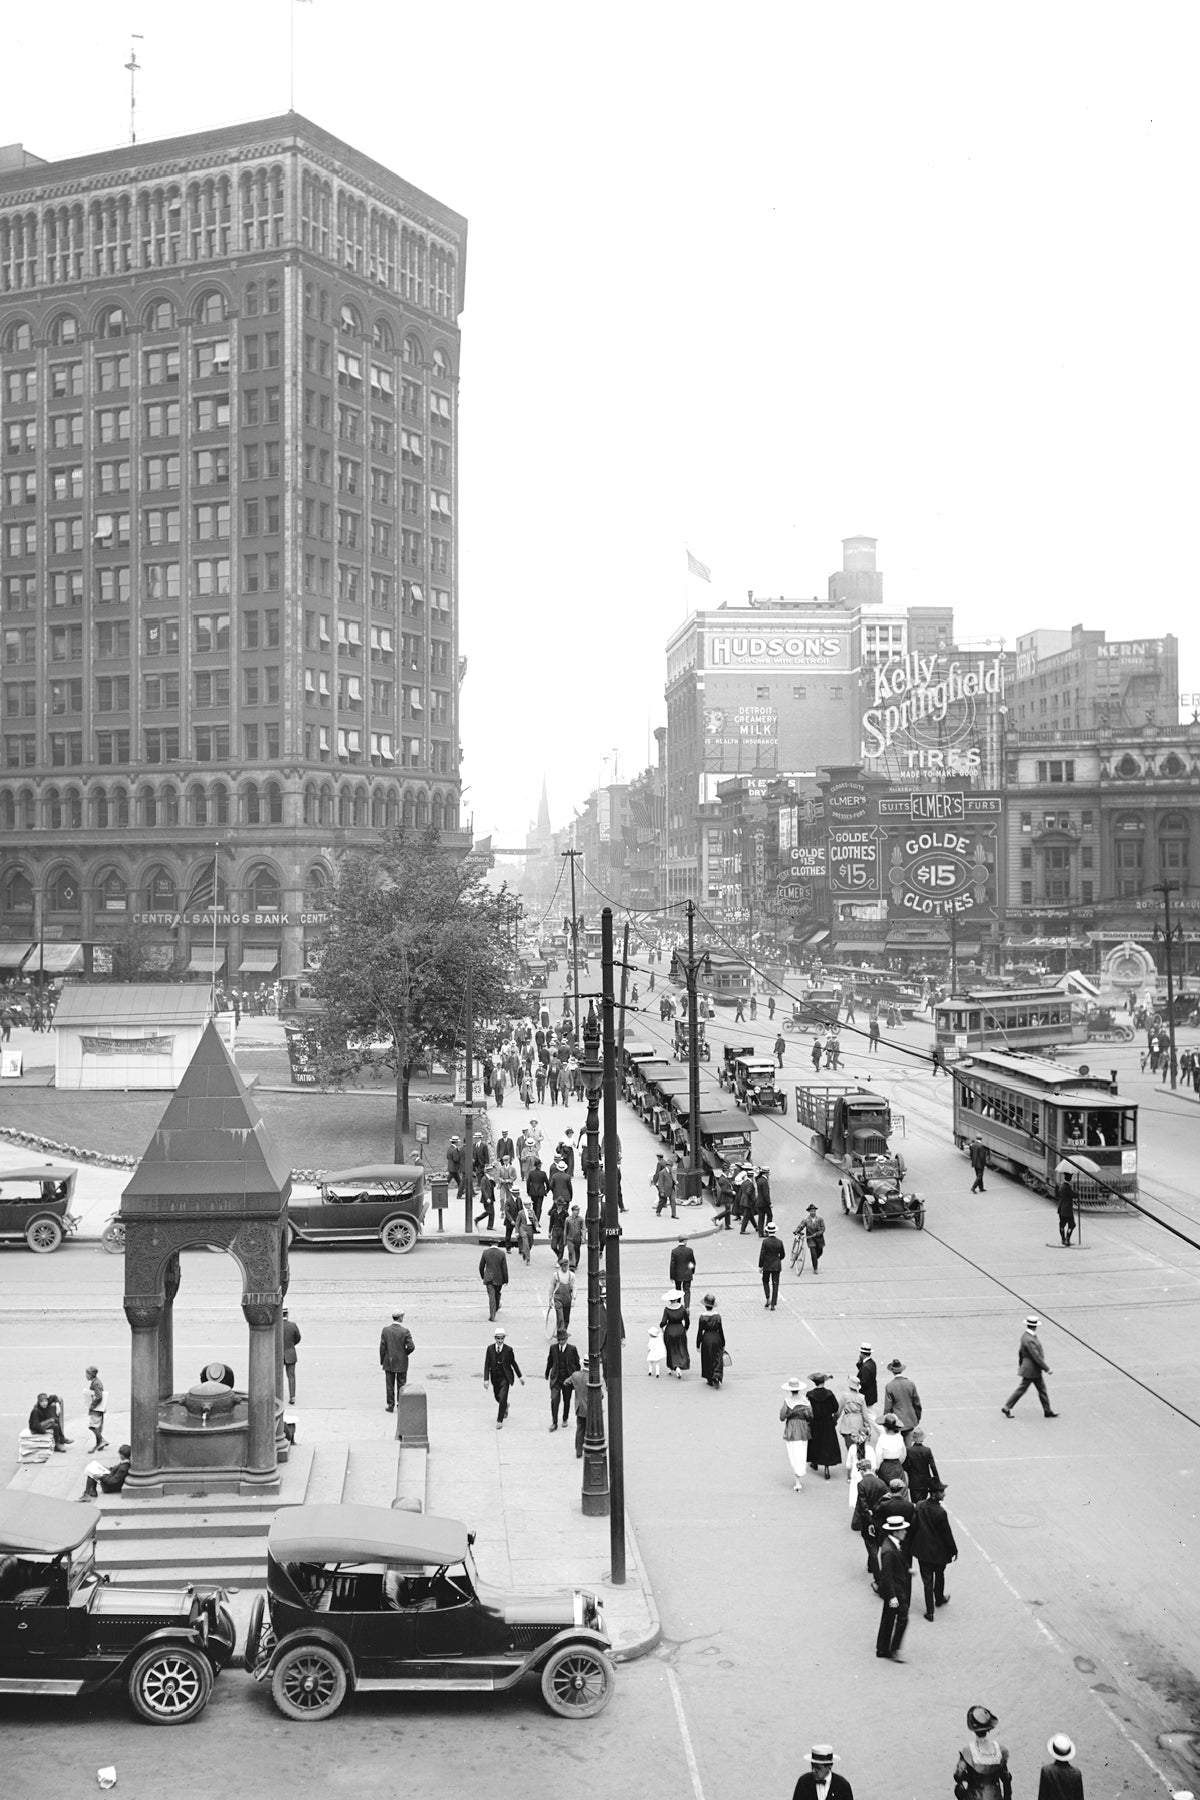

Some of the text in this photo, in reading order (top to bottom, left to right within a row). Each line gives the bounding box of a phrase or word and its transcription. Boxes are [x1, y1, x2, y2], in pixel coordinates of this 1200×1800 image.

[712, 636, 841, 665] HUDSON'S
[1097, 641, 1164, 657] KERN'S
[739, 707, 773, 715] DETROIT
[860, 658, 1000, 758] Springfield
[740, 725, 772, 735] MILK
[903, 748, 981, 768] TIRES
[900, 769, 979, 778] MADE TO MAKE GOOD
[829, 795, 867, 806] ELMER'S
[913, 794, 962, 818] ELMER'S
[968, 801, 996, 810] FURS
[881, 803, 910, 811] SUITS
[835, 832, 869, 843] GOLDE
[905, 832, 970, 855] GOLDE
[791, 848, 825, 859] GOLDE
[831, 845, 876, 861] CLOTHES
[791, 866, 826, 876] CLOTHES
[839, 863, 867, 885] $15
[917, 865, 956, 886] $15
[903, 892, 974, 916] CLOTHES
[193, 913, 250, 924] SAVINGS
[254, 913, 289, 924] BANK
[605, 1228, 619, 1236] FORT
